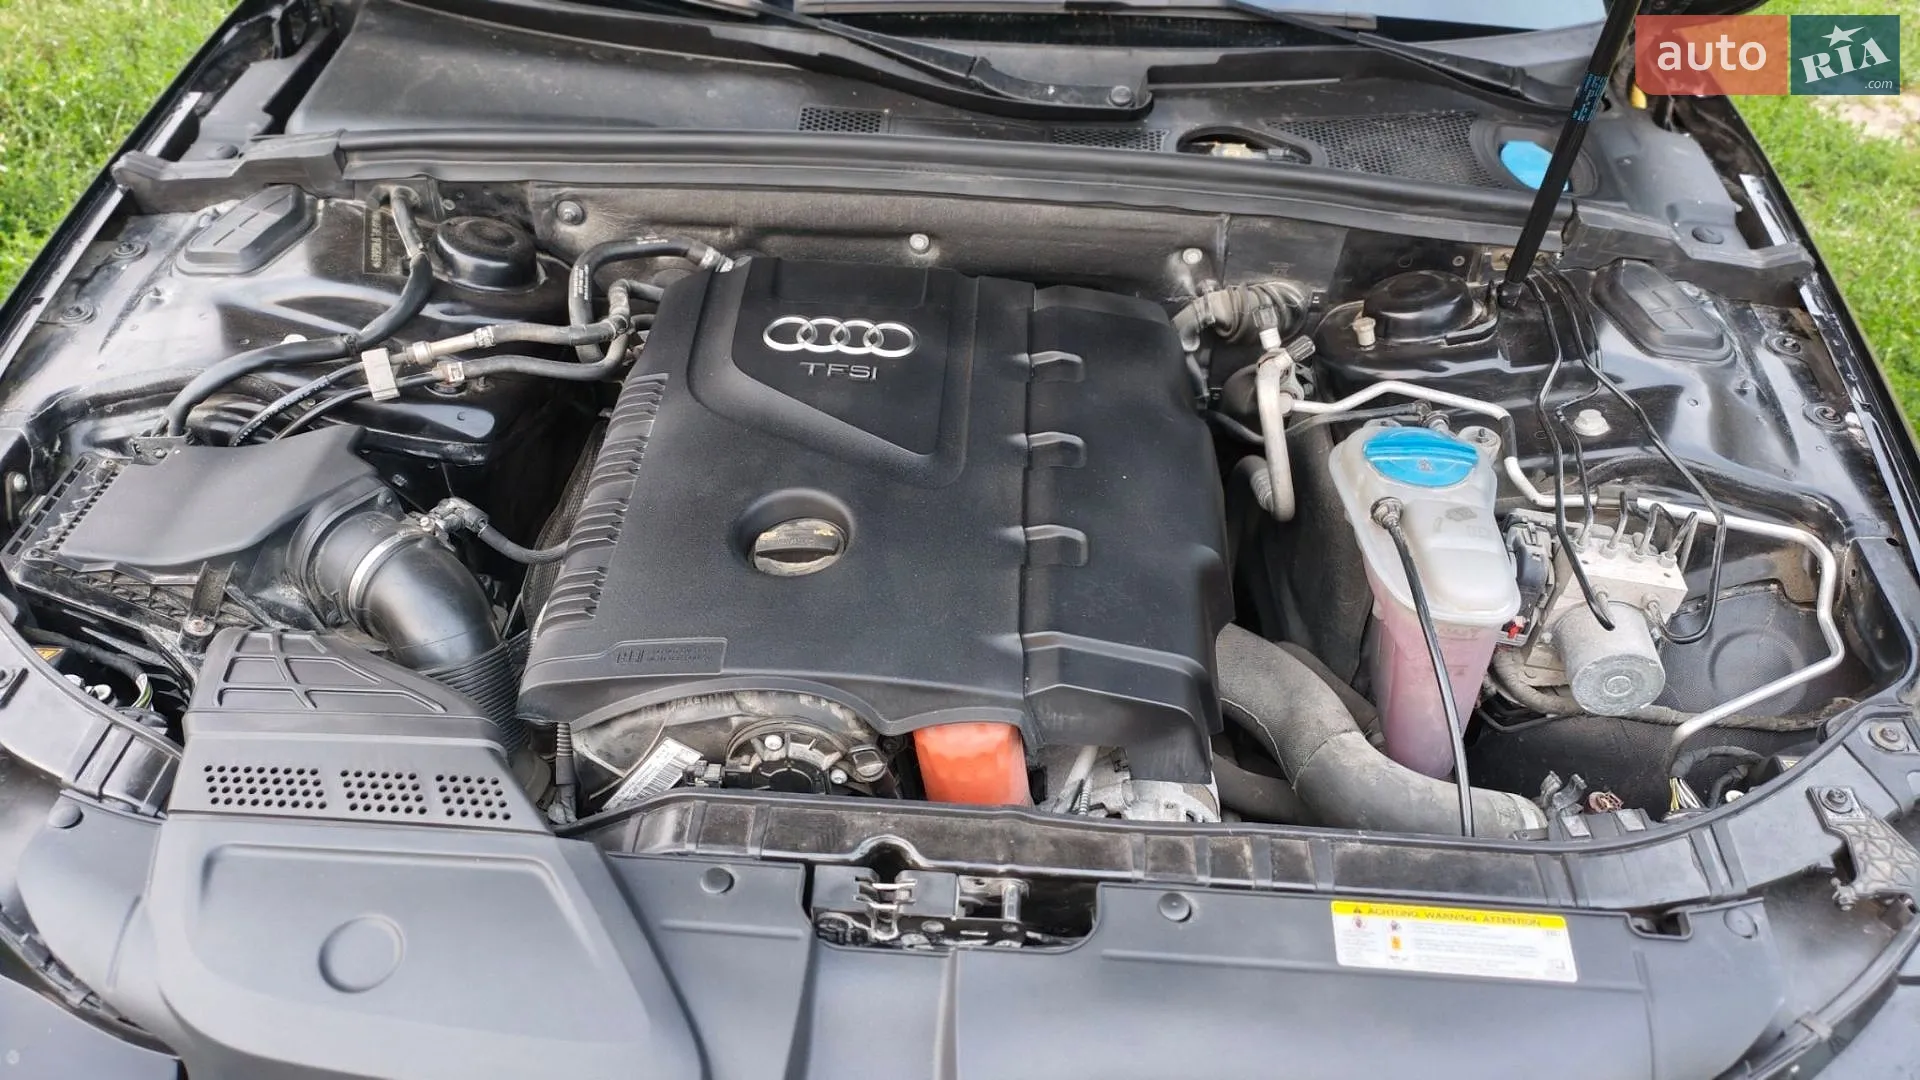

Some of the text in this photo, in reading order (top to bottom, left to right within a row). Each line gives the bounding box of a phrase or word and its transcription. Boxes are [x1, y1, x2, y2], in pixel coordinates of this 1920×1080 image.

[800, 361, 878, 381] TFSI
[1367, 907, 1542, 927] ACHTUNG WARNING ATTENTION
